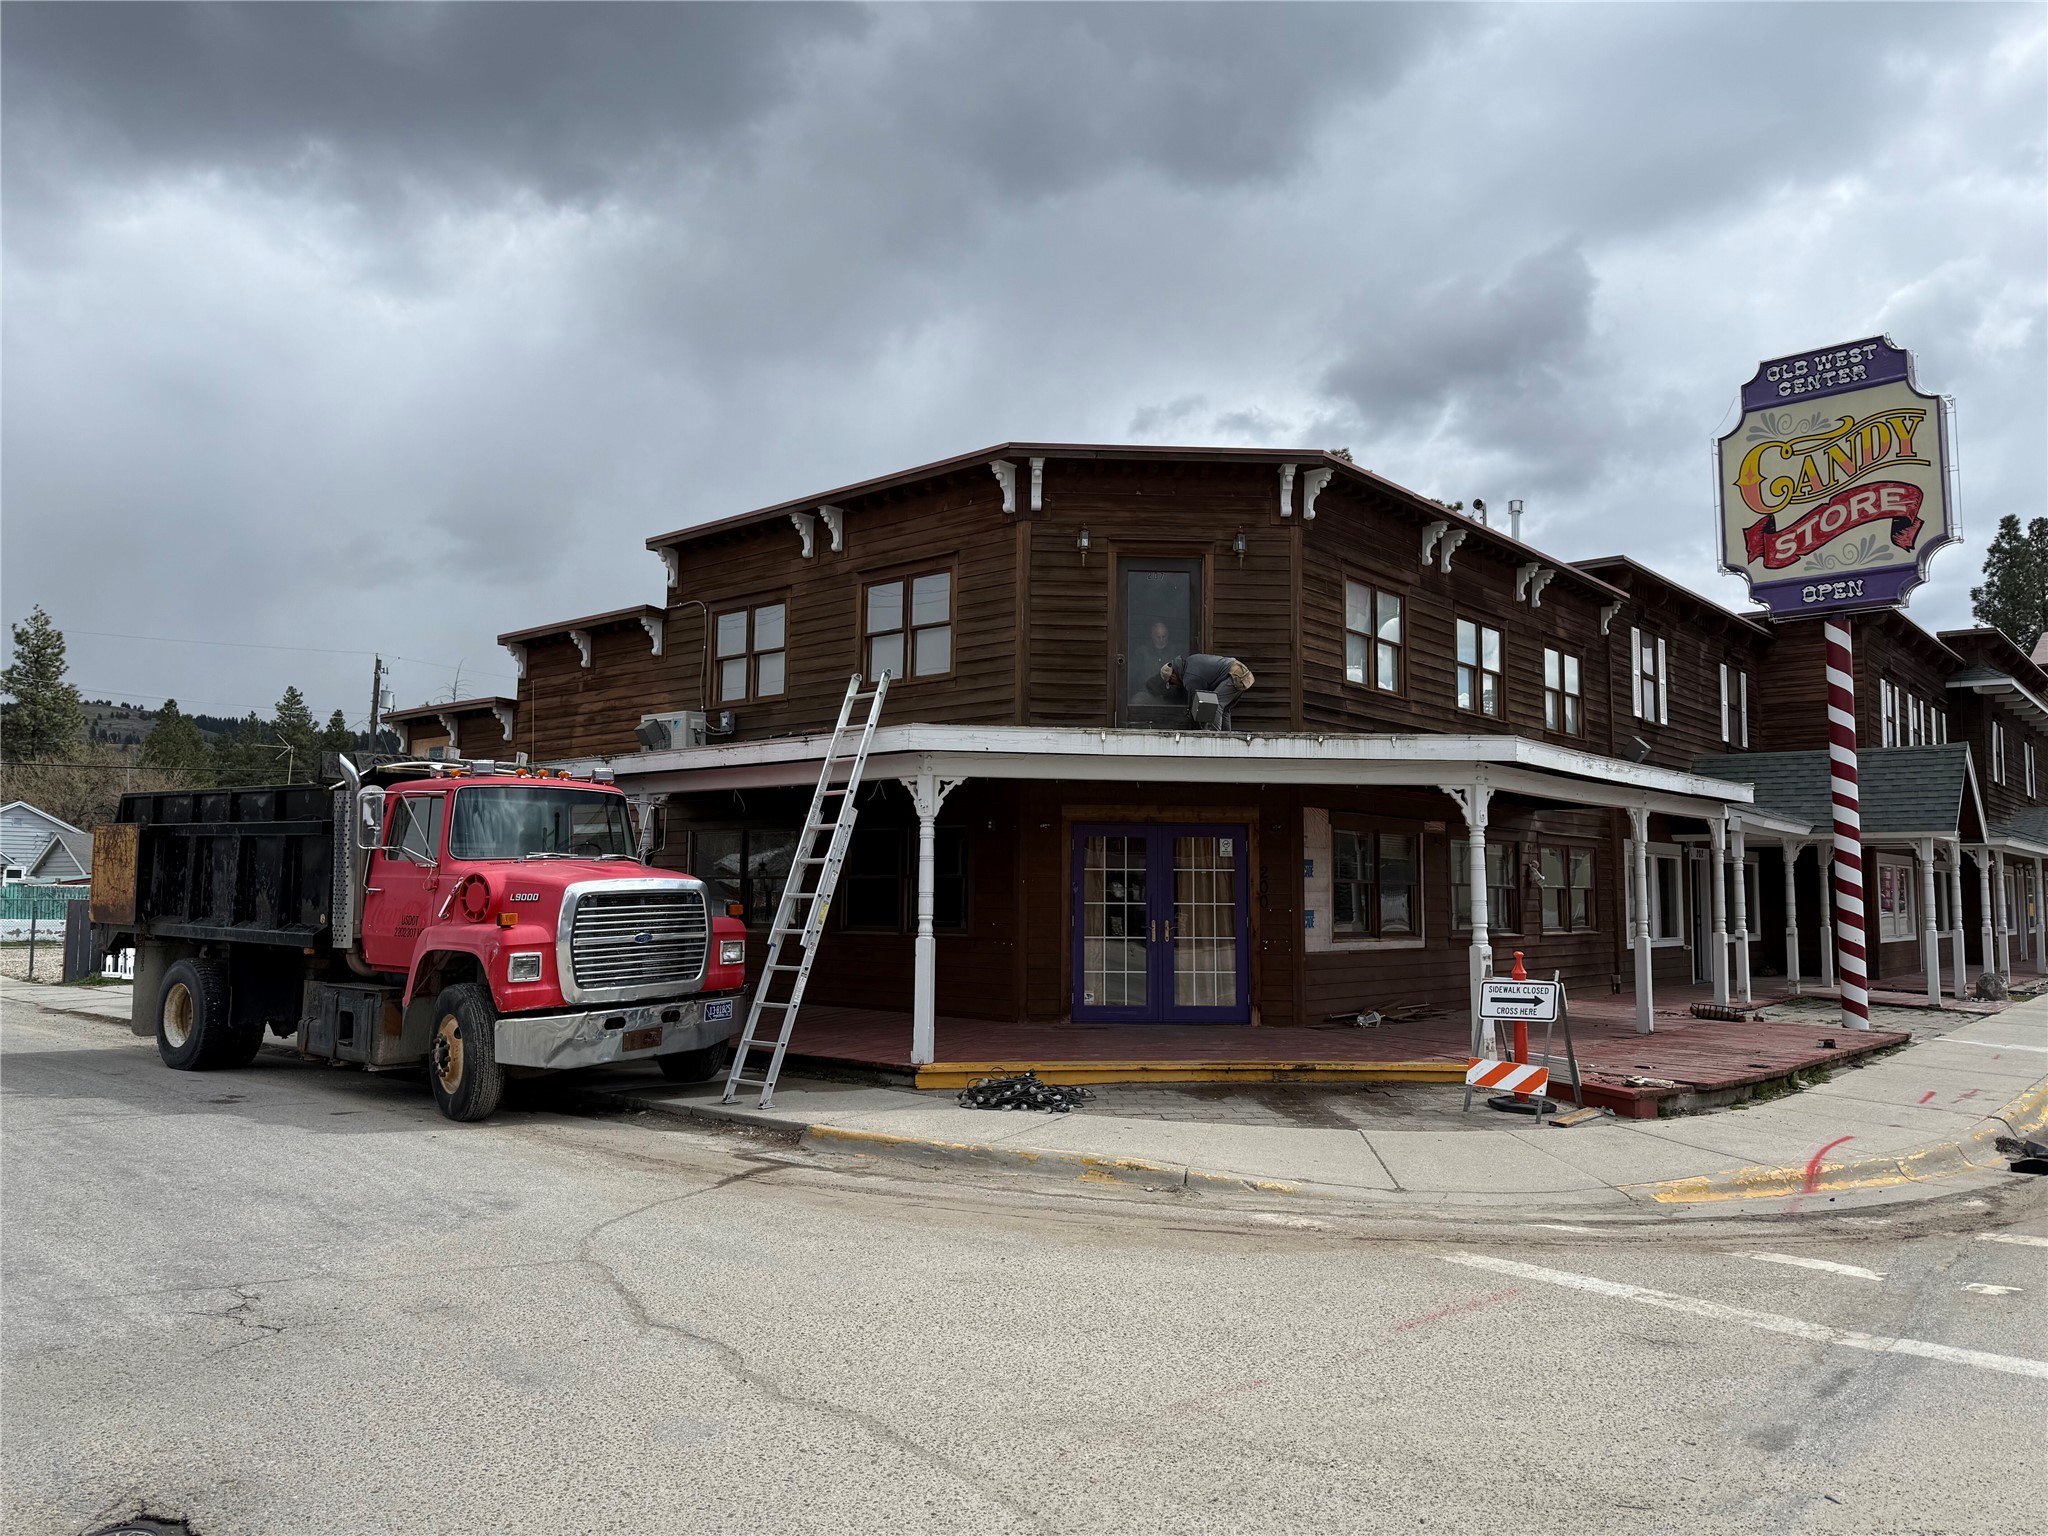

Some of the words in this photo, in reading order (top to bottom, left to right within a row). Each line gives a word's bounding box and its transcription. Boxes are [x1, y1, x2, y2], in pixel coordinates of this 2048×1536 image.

[1766, 360, 1808, 382] OLD
[1813, 343, 1878, 371] WEST
[1777, 365, 1868, 397] CENTER
[1733, 412, 1928, 515] CANDY
[1774, 487, 1909, 560] STORE
[1801, 579, 1865, 603] OPEN
[509, 893, 539, 901] L9000
[401, 915, 420, 926] USDOT
[1488, 985, 1521, 994] SIDEWALK
[1522, 986, 1549, 995] CLOSED
[1496, 1006, 1518, 1015] CROSS
[1519, 1007, 1538, 1016] HERE
